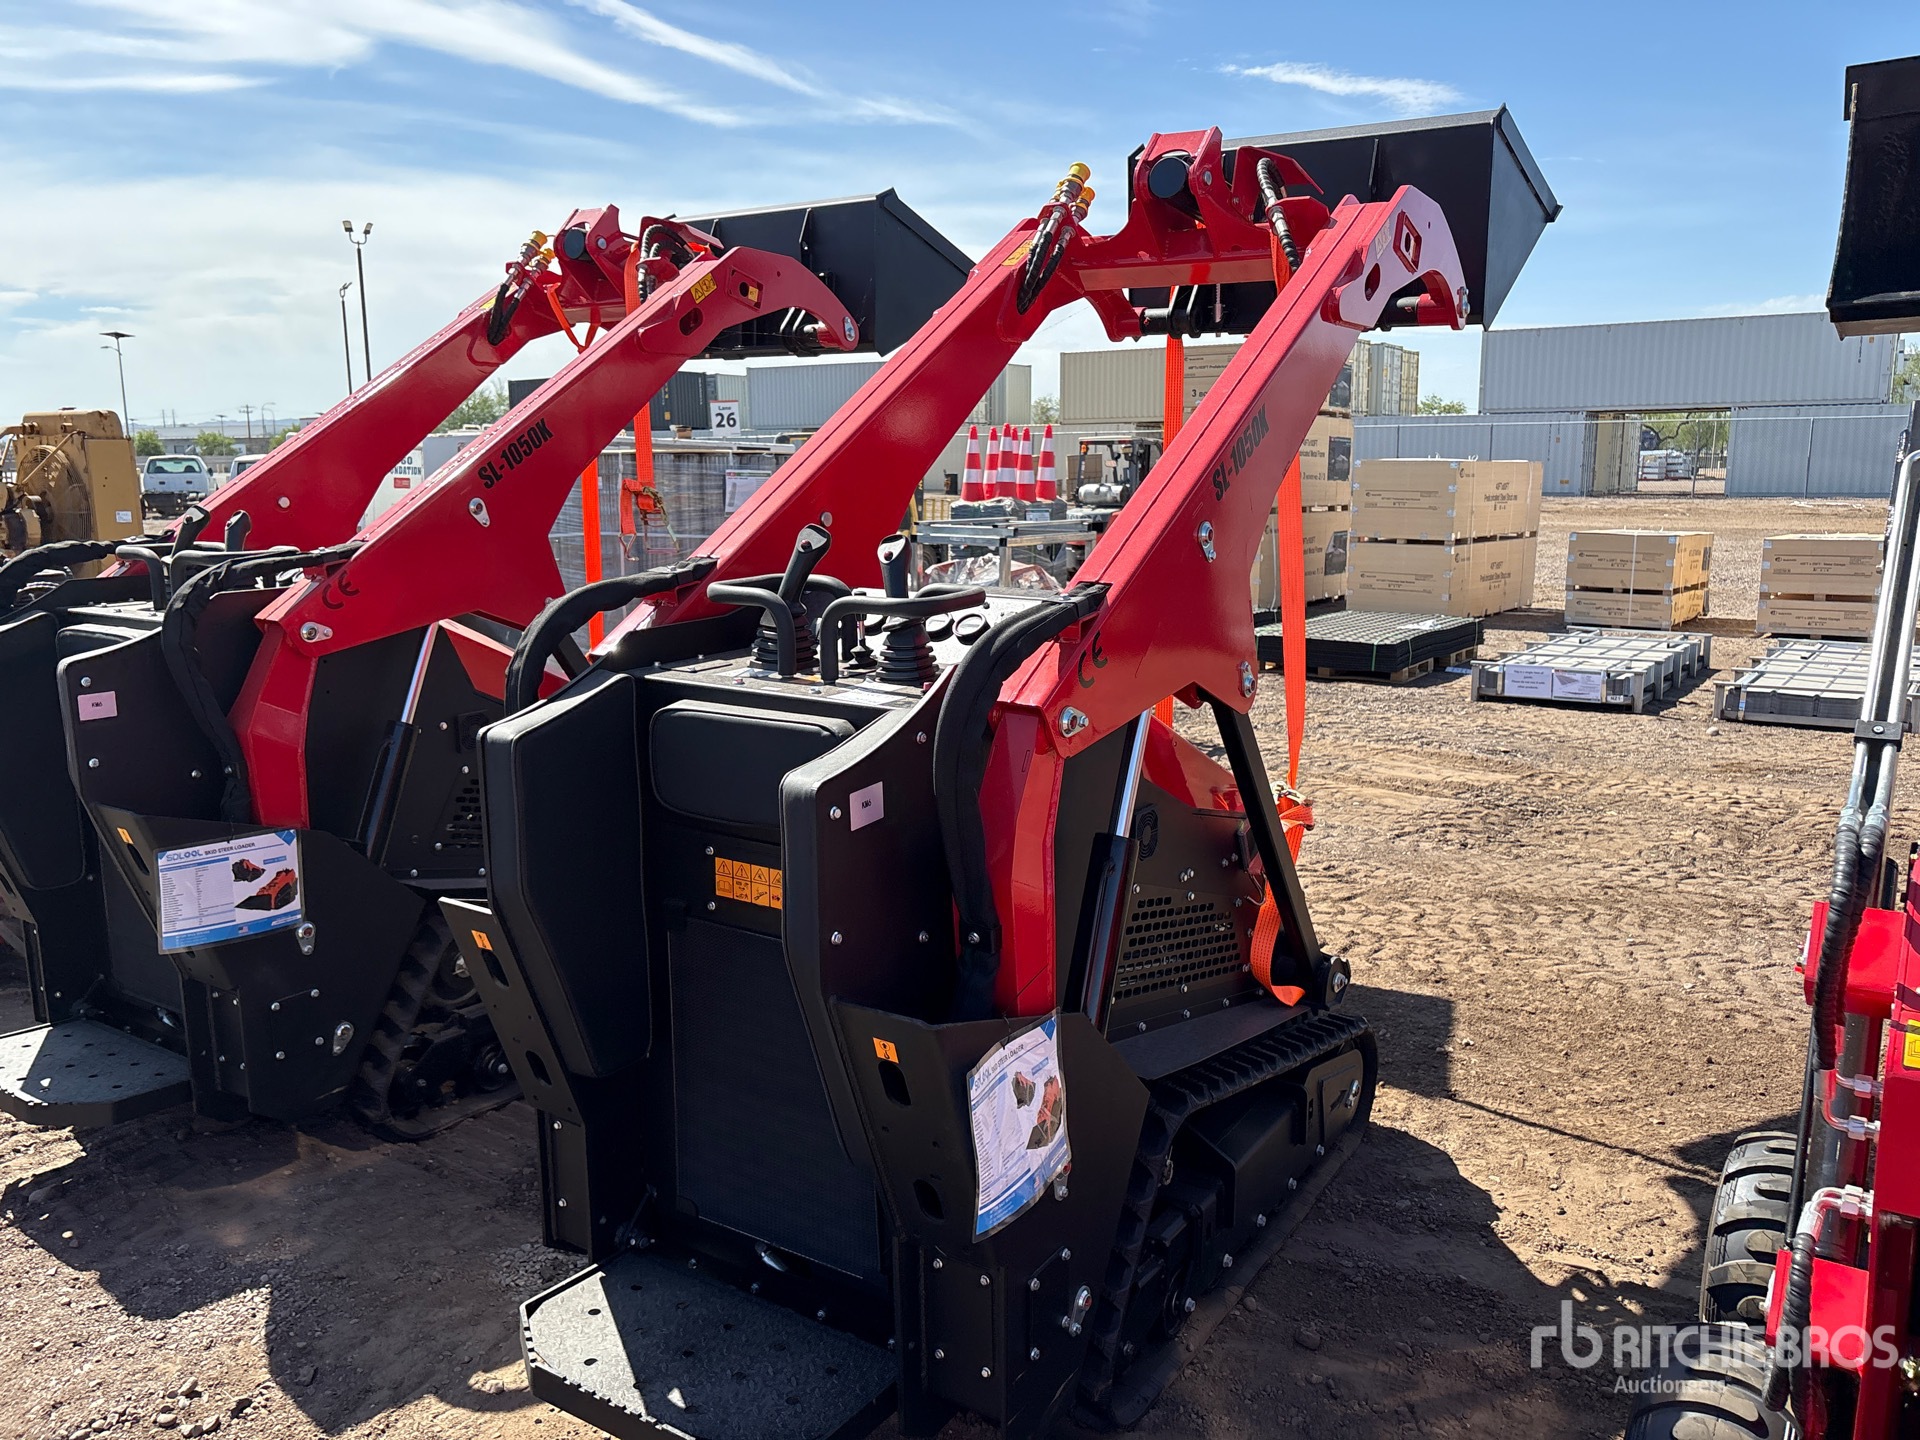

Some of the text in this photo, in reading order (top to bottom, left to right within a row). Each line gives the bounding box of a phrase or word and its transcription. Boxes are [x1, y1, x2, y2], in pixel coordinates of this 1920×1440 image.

[715, 412, 737, 428] 26
[478, 417, 553, 489] SL-1050K
[1212, 403, 1270, 502] SL-1050K
[322, 570, 361, 610] CE
[1078, 631, 1109, 688] CE
[218, 845, 234, 854] STEER
[234, 842, 256, 851] LOADER
[1007, 1044, 1024, 1059] LOADER
